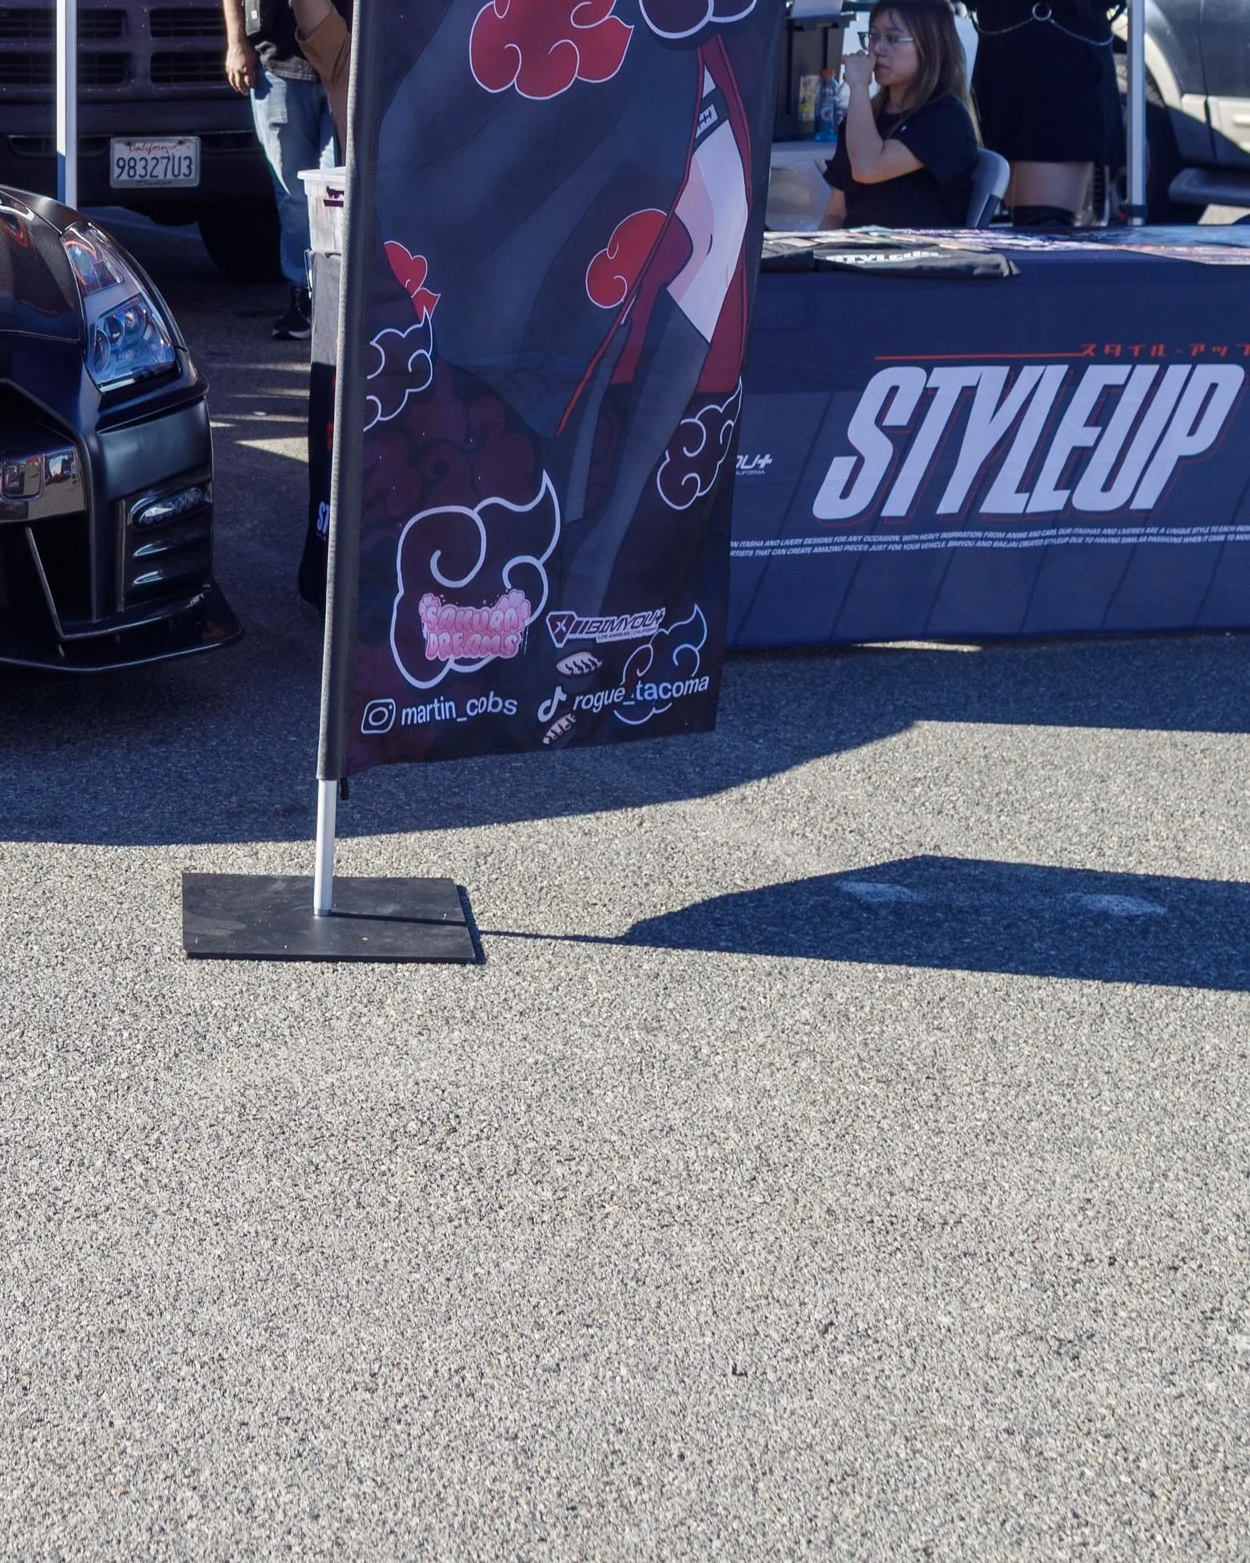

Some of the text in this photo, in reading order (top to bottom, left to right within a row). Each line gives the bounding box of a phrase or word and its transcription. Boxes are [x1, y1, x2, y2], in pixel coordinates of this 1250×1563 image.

[128, 141, 181, 156] California
[115, 155, 193, 180] 98327U3
[812, 364, 1245, 521] STYLEUP
[424, 604, 520, 633] SAKURA
[426, 631, 519, 660] DREAMS
[401, 691, 518, 726] martin_cobs
[573, 675, 710, 713] rogue_tacoma
